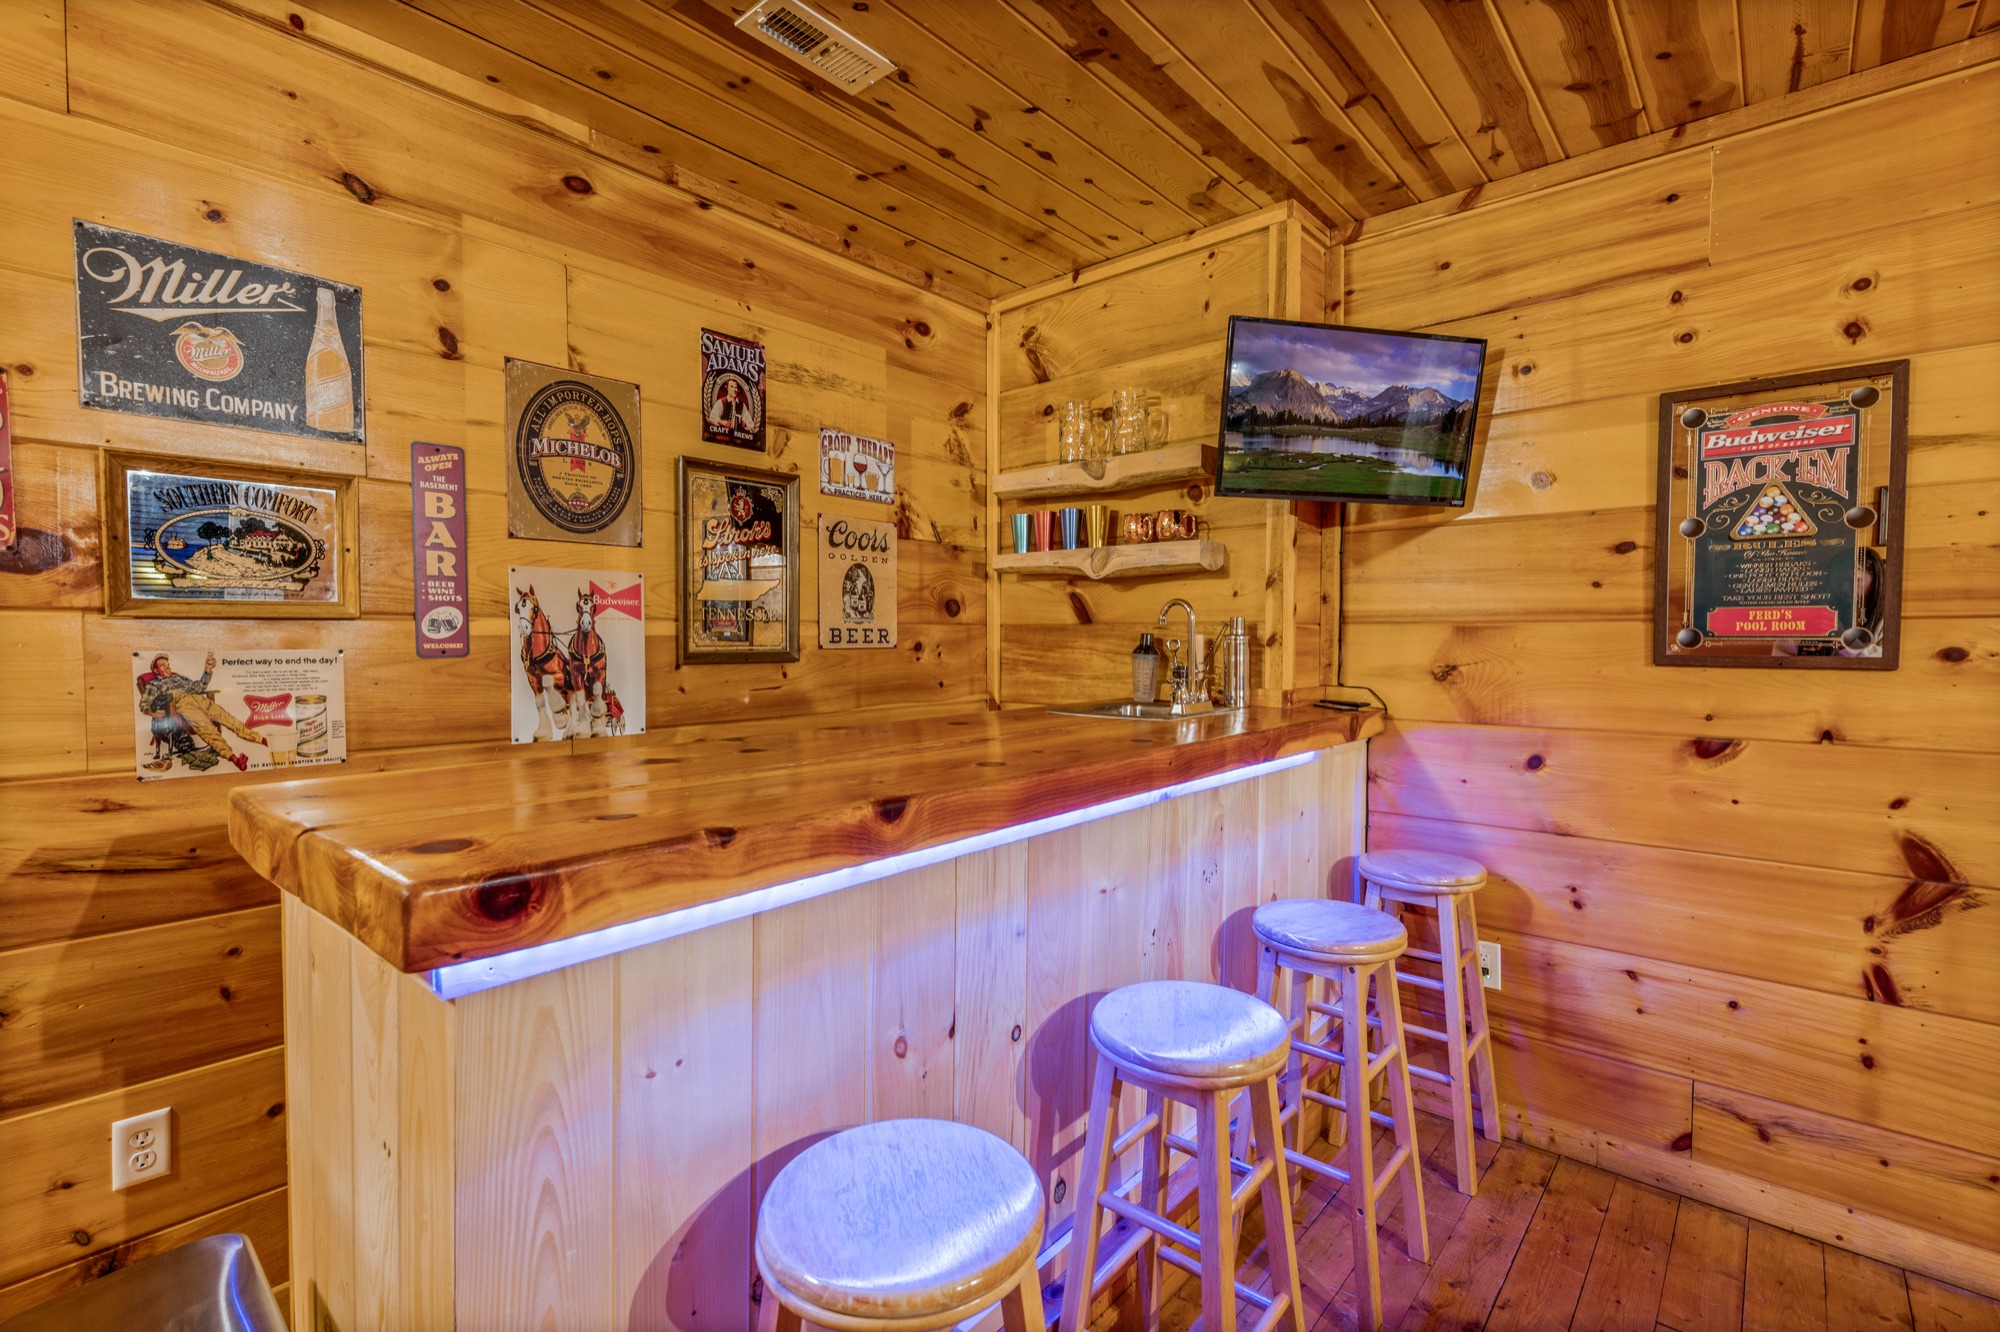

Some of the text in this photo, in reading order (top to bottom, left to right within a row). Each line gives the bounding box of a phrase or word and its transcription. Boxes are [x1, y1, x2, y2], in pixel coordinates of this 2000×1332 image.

[82, 247, 297, 305] Miller
[184, 345, 231, 359] Miller
[702, 333, 765, 368] SAMUEL
[706, 354, 758, 382] ADAMS
[100, 371, 199, 408] BREWING
[205, 388, 298, 421] COMPANY
[531, 391, 622, 445] ALL IMPORTED HOPS
[1737, 405, 1811, 421] GENUINE
[709, 425, 754, 440] CRAFT BREWS
[1704, 424, 1850, 449] Budweiser
[821, 434, 894, 466] GROUP THERAPY
[1783, 439, 1815, 447] BEERS
[417, 453, 458, 463] ALWAYS
[530, 437, 622, 468] MICHELOB
[424, 462, 452, 471] OPEN
[562, 458, 592, 467] LAGER
[420, 481, 458, 491] BASEMENT
[432, 475, 446, 483] THE
[834, 488, 883, 502] PRACTICED HERE
[153, 483, 317, 524] SOUTHERN COMFORT
[424, 491, 457, 577] BAR
[702, 517, 772, 550] Stroh's
[826, 520, 890, 553] Coors
[698, 545, 779, 569] is spoken here.
[828, 552, 888, 564] GOLDEN
[1743, 550, 1756, 560] Of
[428, 594, 463, 602] SHOTS
[701, 607, 777, 622] TENNESSEE
[1748, 610, 1792, 620] FERD'S
[1735, 620, 1805, 632] POOL ROOM
[829, 627, 890, 644] BEER
[222, 658, 253, 666] Perfect
[255, 659, 272, 667] way
[285, 657, 301, 665] end
[318, 656, 338, 666] day!
[251, 700, 284, 713] Miller
